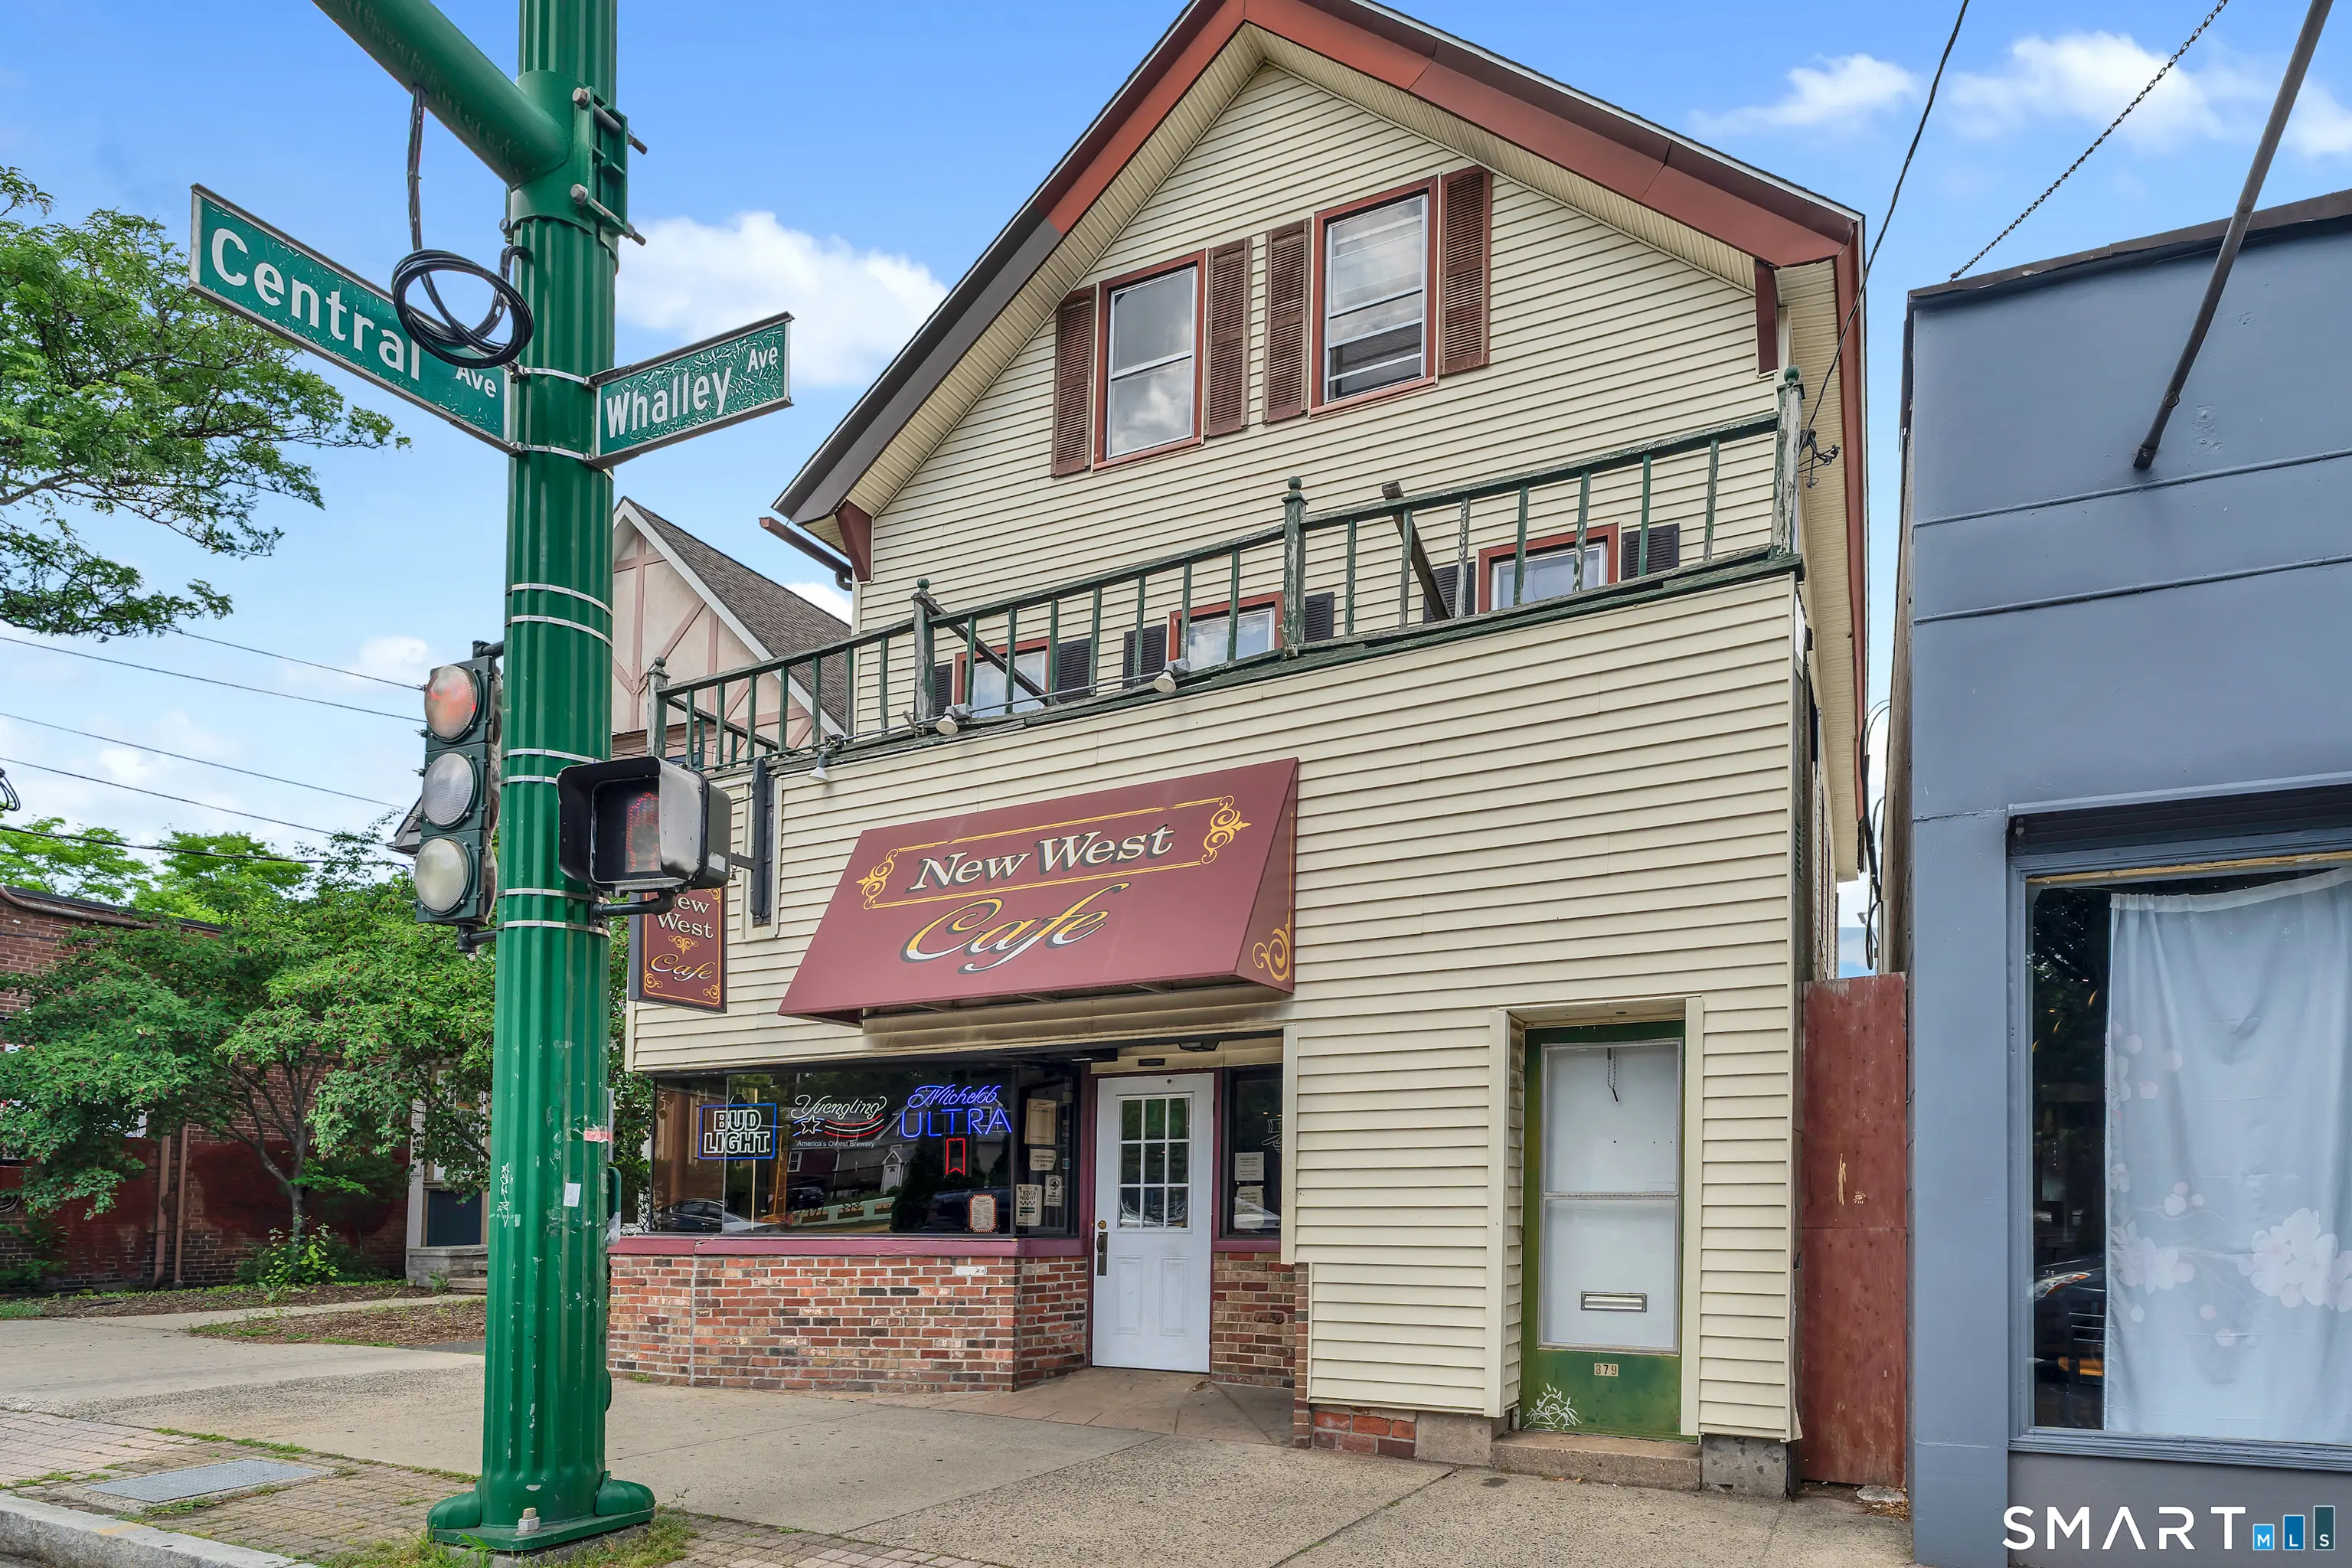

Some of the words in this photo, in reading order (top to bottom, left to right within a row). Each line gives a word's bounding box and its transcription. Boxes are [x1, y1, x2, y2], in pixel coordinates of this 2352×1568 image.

[211, 227, 420, 381] Central
[455, 367, 497, 398] Ave
[606, 366, 733, 439] Whalley
[746, 345, 778, 373] Ave
[905, 851, 1033, 894] New
[1035, 824, 1175, 875] West
[675, 897, 710, 914] ew
[658, 912, 714, 939] West
[900, 882, 1131, 974] Cafe
[649, 953, 715, 982] Cafe
[791, 1094, 887, 1119] Yuengling
[907, 1083, 1001, 1108] Michelob
[714, 1109, 762, 1132] BUD
[901, 1108, 1012, 1138] ULTRA
[1596, 1364, 1617, 1376] 879
